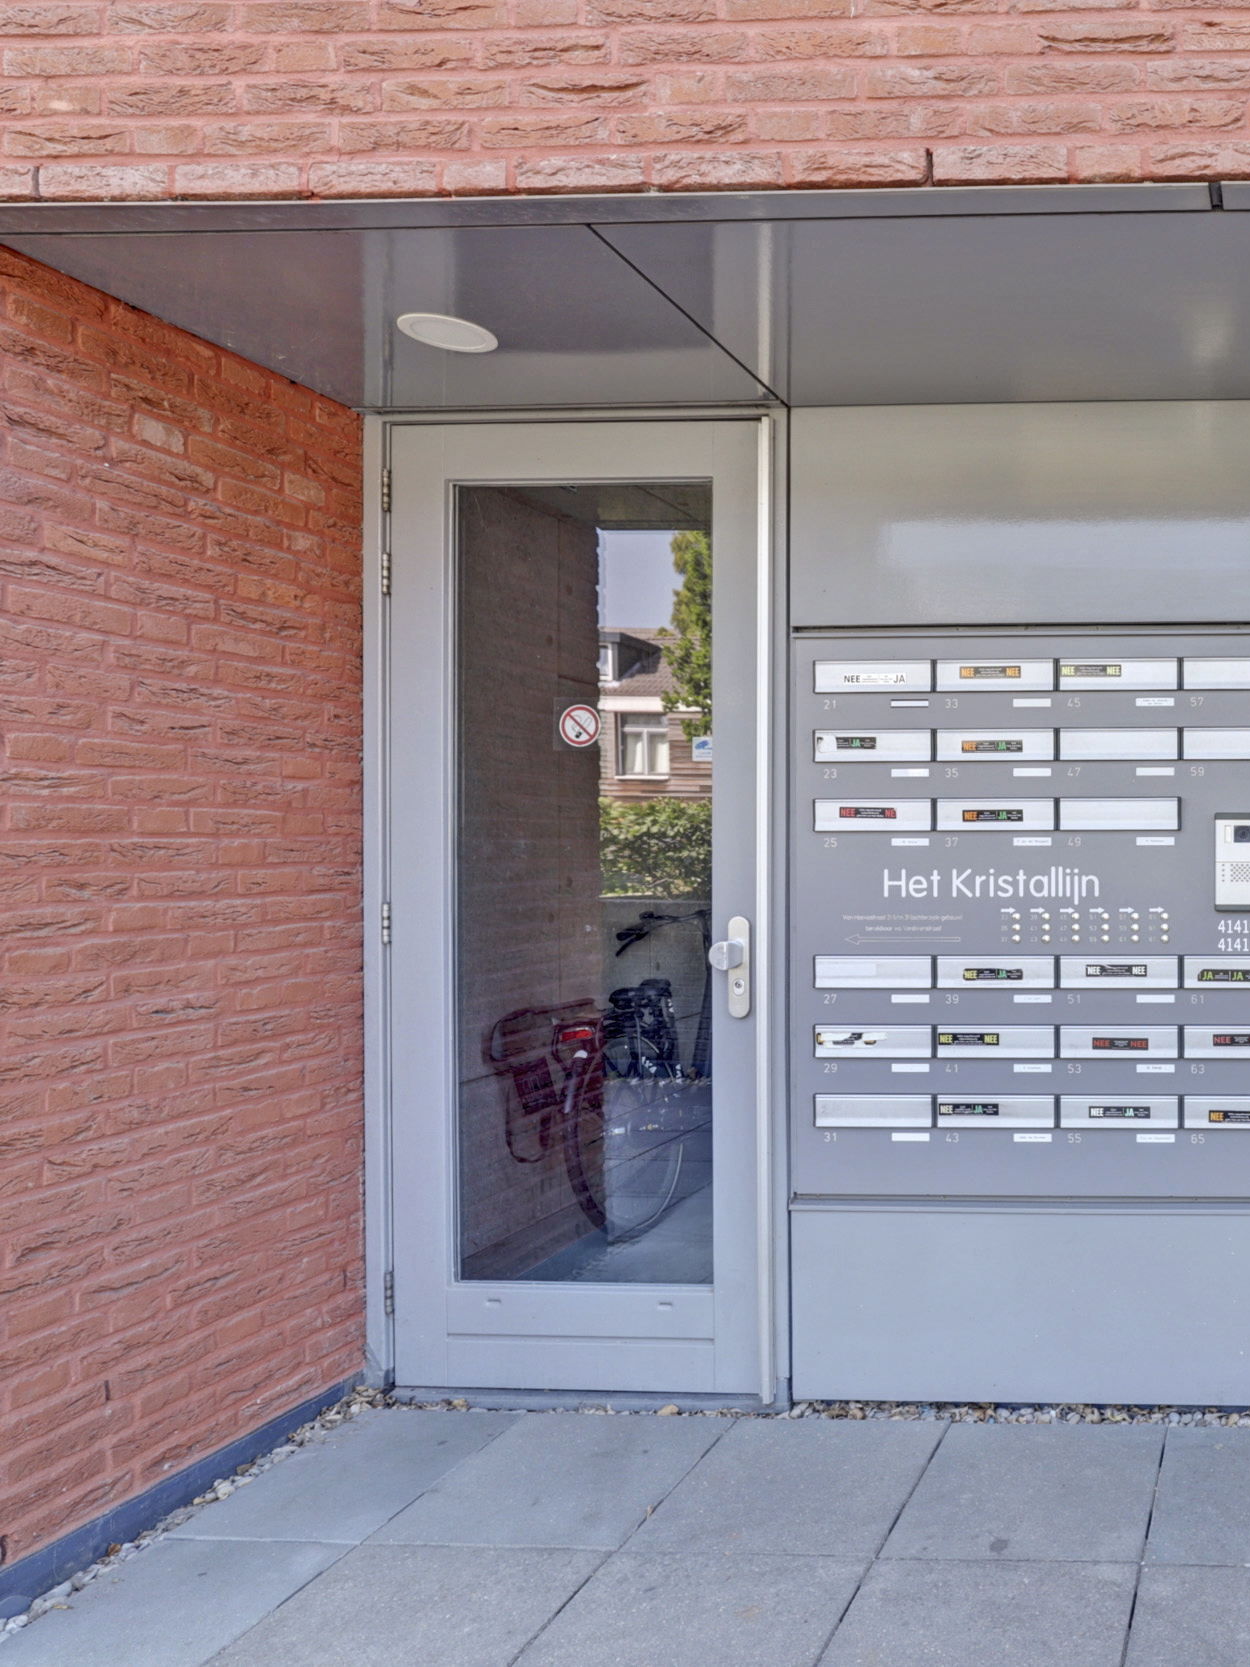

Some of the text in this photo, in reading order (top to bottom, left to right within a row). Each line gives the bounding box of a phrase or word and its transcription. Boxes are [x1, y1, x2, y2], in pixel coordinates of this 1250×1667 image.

[961, 668, 975, 677] NEE
[1006, 667, 1019, 677] NEE
[1061, 666, 1121, 676] NEE NEE
[843, 674, 905, 683] NEE JA
[823, 699, 837, 710] 21
[944, 698, 959, 709] 33
[1067, 697, 1081, 708] 45
[1190, 696, 1204, 707] 57
[850, 738, 861, 748] JA
[963, 741, 1007, 751] NEE JA
[824, 769, 838, 779] 23
[944, 767, 959, 779] 35
[1067, 767, 1081, 777] 47
[1190, 766, 1205, 777] 59
[840, 808, 855, 817] NEE
[964, 810, 1008, 820] NEE JA
[823, 837, 838, 848] 25
[944, 837, 959, 848] 37
[1067, 837, 1082, 848] 49
[883, 866, 1100, 905] Het Kristallijn
[964, 970, 1007, 979] NEE JA
[1087, 965, 1146, 975] NEE NEE
[1202, 971, 1244, 981] JA JA
[823, 994, 837, 1004] 27
[944, 993, 959, 1004] 39
[1067, 993, 1081, 1004] 51
[1190, 994, 1205, 1004] 61
[939, 1034, 998, 1044] NEE NEE
[1130, 1040, 1147, 1048] NEE
[1213, 1036, 1232, 1044] NEE
[823, 1063, 838, 1074] 29
[944, 1063, 958, 1074] 41
[1067, 1063, 1082, 1074] 53
[1190, 1063, 1205, 1075] 63
[940, 1105, 983, 1114] NEE JA
[1090, 1108, 1135, 1117] NEE JA
[1210, 1112, 1224, 1121] NEE
[823, 1132, 837, 1143] 31
[944, 1132, 959, 1143] 43
[1067, 1133, 1082, 1144] 55
[1190, 1133, 1205, 1144] 65
